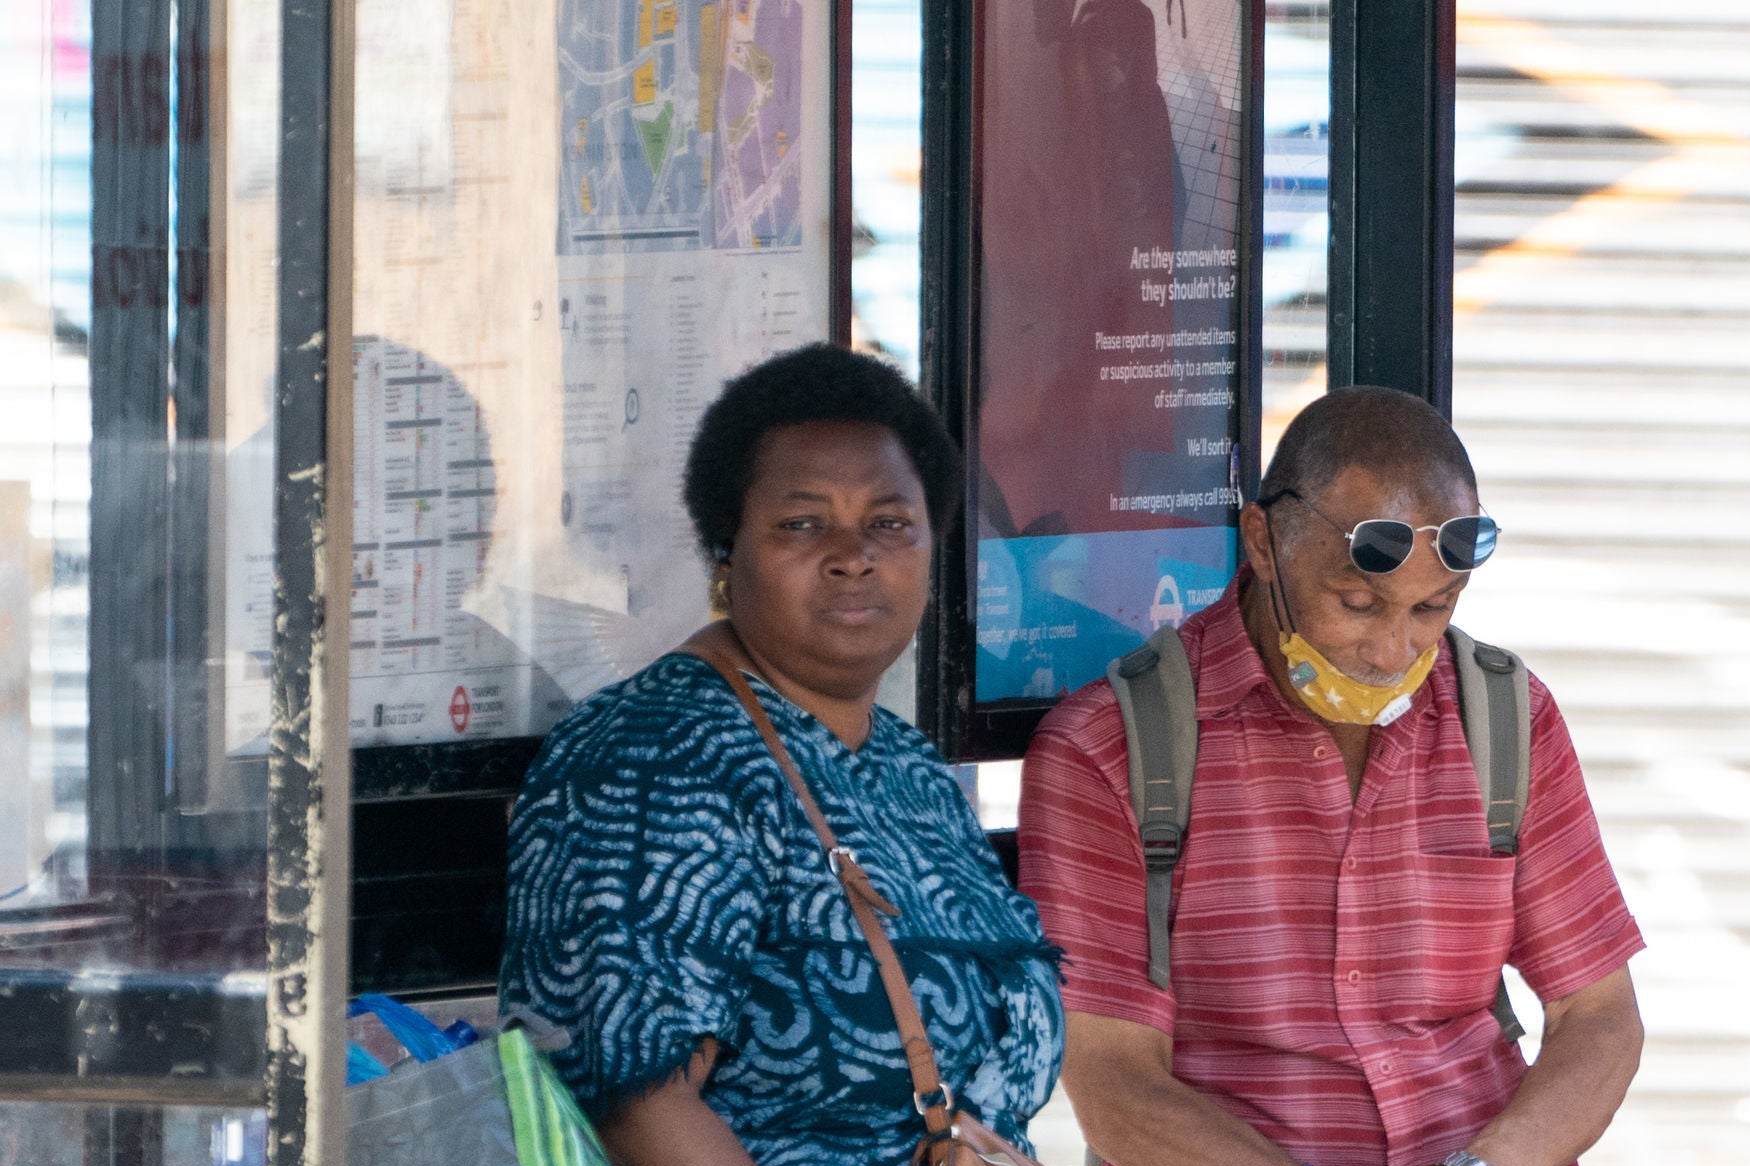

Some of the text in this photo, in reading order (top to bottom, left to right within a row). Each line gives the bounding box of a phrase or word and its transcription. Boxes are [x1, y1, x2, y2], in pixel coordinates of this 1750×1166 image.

[1130, 244, 1236, 274] Are they somewhere
[1141, 275, 1236, 307] they shouldn't be?
[1095, 327, 1236, 353] Please report any unattended items
[1100, 366, 1109, 380] or
[1110, 361, 1153, 383] suspicious
[1154, 359, 1185, 381] activity
[1186, 360, 1194, 376] to
[1202, 357, 1235, 375] member
[1154, 387, 1235, 409] of staff immediately.
[1187, 438, 1207, 456] We'll
[1208, 438, 1224, 455] sort
[1110, 493, 1118, 511] In
[1119, 497, 1129, 511] an
[1130, 495, 1175, 514] emergency
[1175, 489, 1204, 511] always
[1204, 487, 1218, 506] call
[1187, 588, 1226, 604] TRANSPO
[1029, 628, 1040, 645] got
